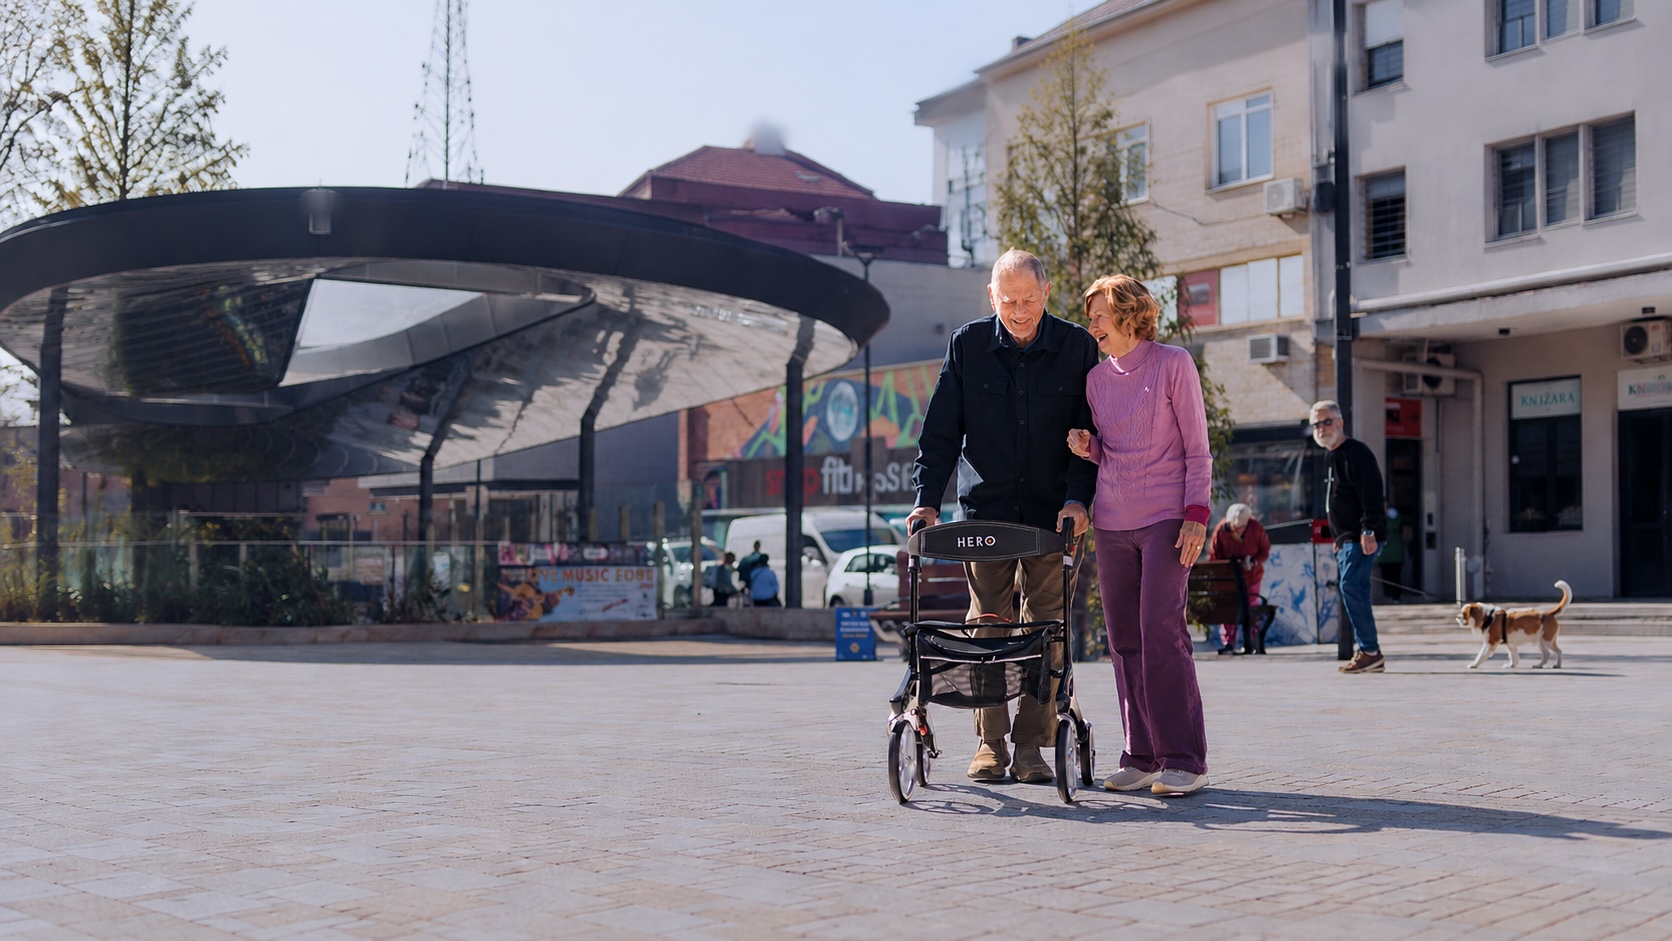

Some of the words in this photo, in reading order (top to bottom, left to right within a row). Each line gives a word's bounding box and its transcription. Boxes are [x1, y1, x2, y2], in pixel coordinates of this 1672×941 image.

[764, 466, 820, 505] snp
[957, 535, 996, 548] HERO
[561, 567, 610, 583] MUSIC
